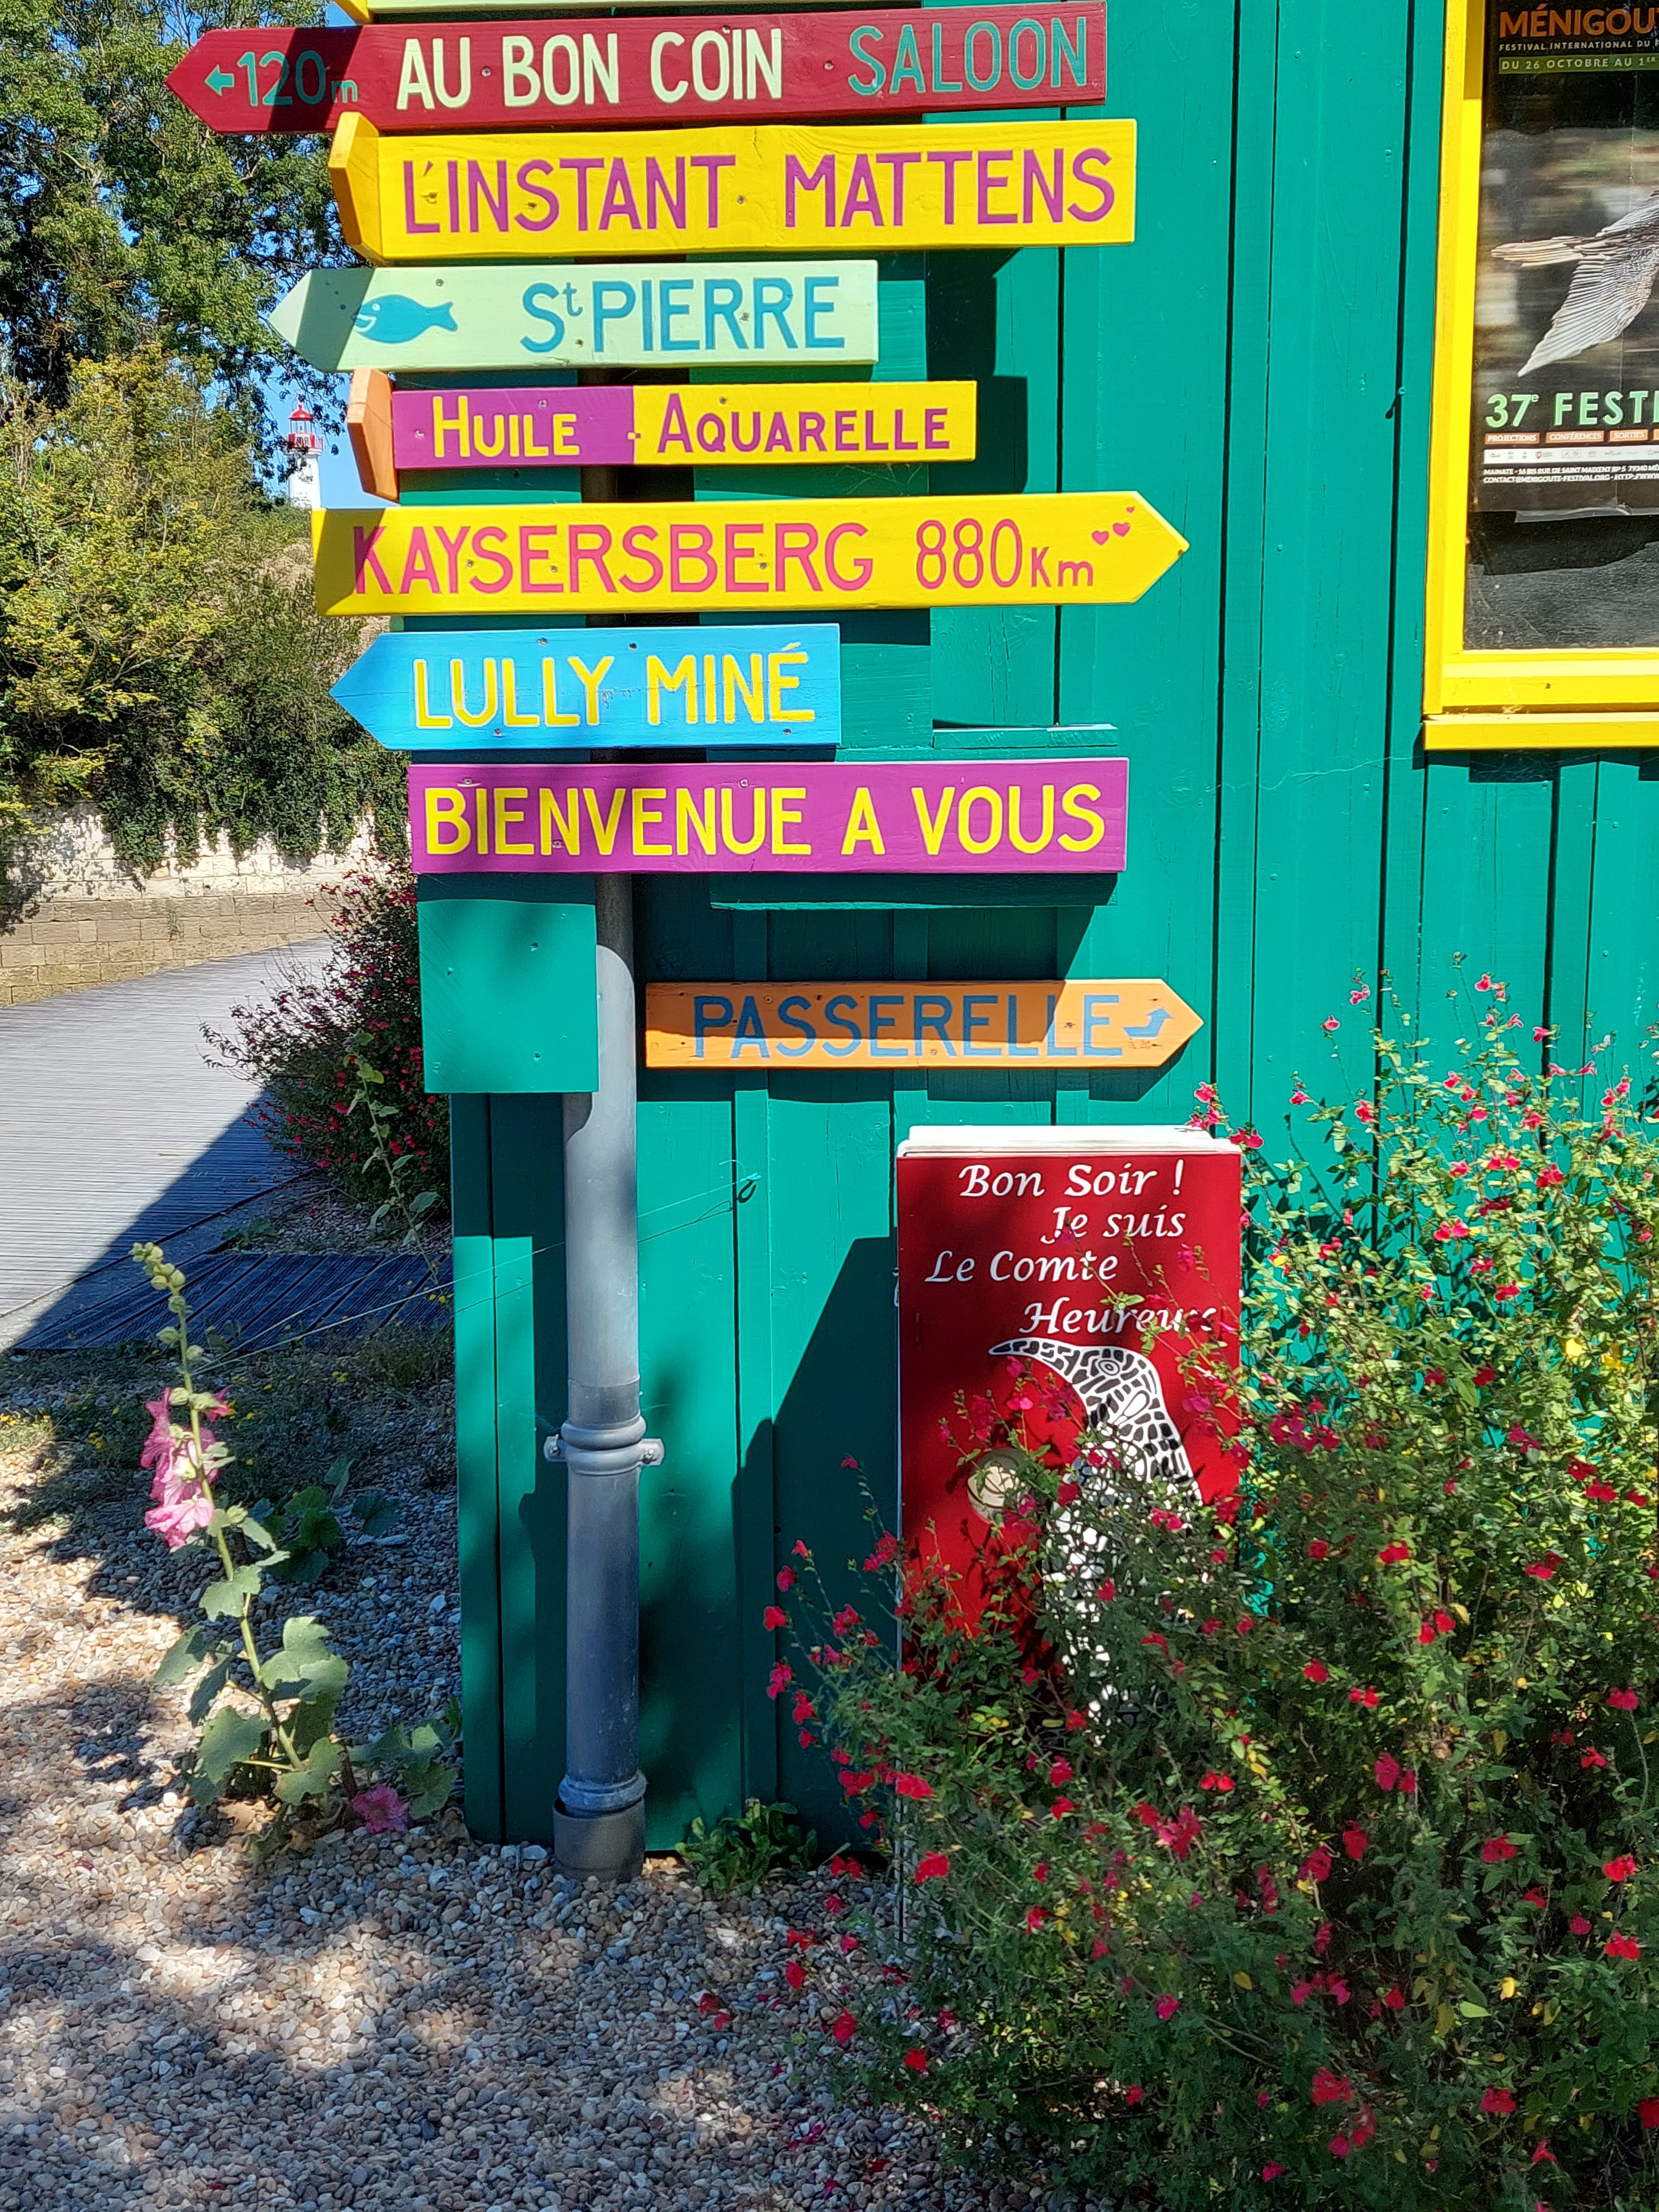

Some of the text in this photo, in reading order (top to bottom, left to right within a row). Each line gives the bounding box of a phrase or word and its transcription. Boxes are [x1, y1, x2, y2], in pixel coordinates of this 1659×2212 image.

[1500, 3, 1659, 38] MÉNIGOU
[1549, 41, 1633, 50] INTERNATIONAL
[396, 36, 471, 111] AU
[502, 33, 619, 108] BON
[651, 28, 783, 104] COIN
[847, 17, 1087, 96] SALOON
[1502, 60, 1519, 70] DU
[1526, 61, 1540, 69] 26
[1546, 58, 1608, 68] OCTOBRE
[1614, 57, 1632, 66] AU
[403, 147, 1116, 234] L'INSTANT MATTENS
[592, 276, 845, 352] PIERRE
[1549, 431, 1602, 440] CONFÉRENCES
[353, 522, 874, 595] KAYSERSBERG
[413, 641, 816, 729] LULLY MINÉ
[424, 783, 1106, 856] BIENVENUE A VOUS
[692, 993, 1124, 1059] PASSERELLE
[958, 1164, 1045, 1197] Bon
[1064, 1162, 1158, 1196] Soir
[1040, 1204, 1186, 1244] Je suis
[924, 1250, 1118, 1283] Le Comte
